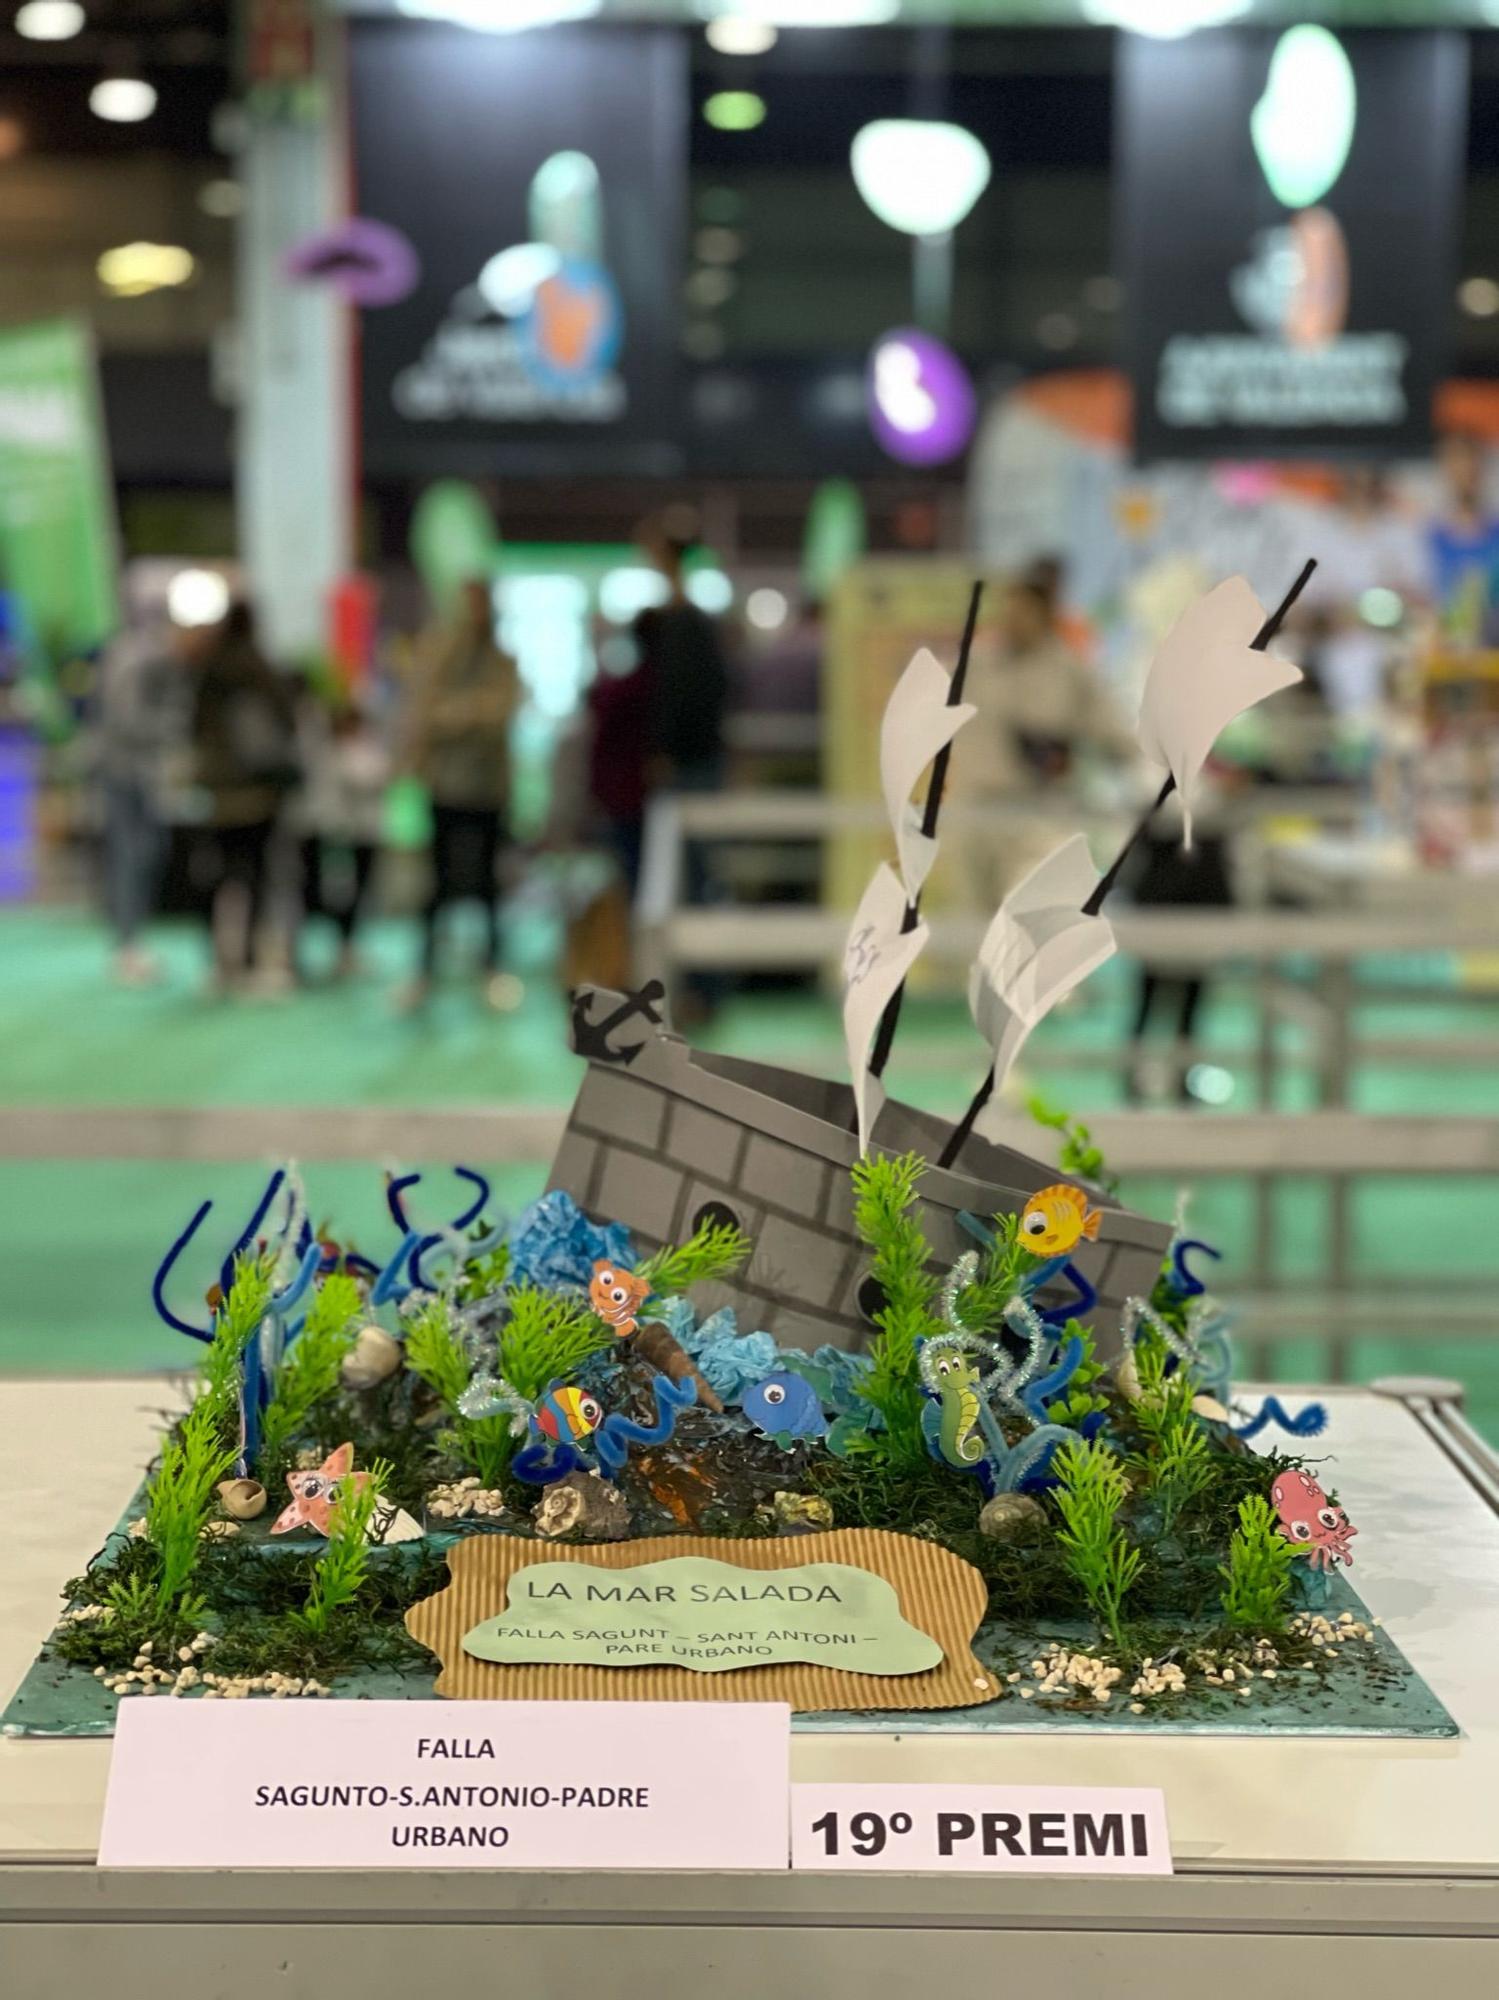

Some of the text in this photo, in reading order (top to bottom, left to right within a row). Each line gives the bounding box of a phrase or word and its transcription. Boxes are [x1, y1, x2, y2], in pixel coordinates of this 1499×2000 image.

[528, 1581, 842, 1603] LA MAR SALADA
[497, 1627, 565, 1640] FALLA
[572, 1628, 669, 1641] SAGUNT
[697, 1631, 757, 1644] SANT
[766, 1630, 856, 1645] ANTONI
[605, 1643, 773, 1658] PARE URBANO
[417, 1738, 496, 1759] FALLA
[255, 1785, 649, 1808] SAGUNTO-S.ANTONIO-PADRE
[392, 1826, 509, 1848] URBANO
[811, 1811, 1148, 1857] 19º PREMI
